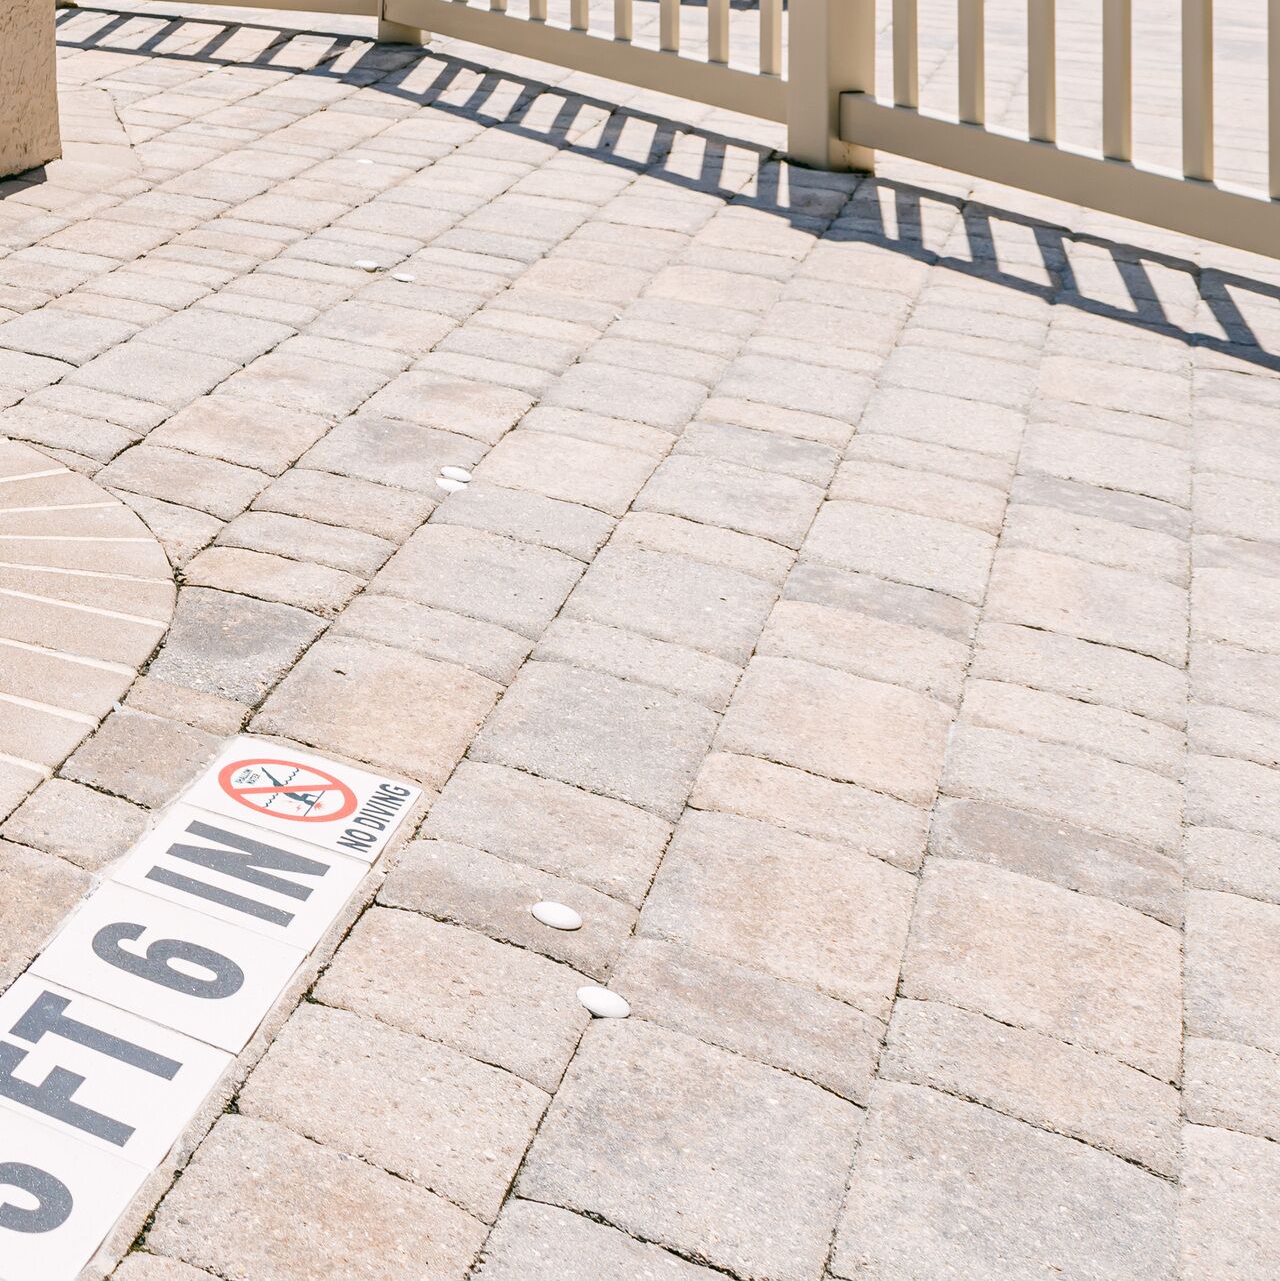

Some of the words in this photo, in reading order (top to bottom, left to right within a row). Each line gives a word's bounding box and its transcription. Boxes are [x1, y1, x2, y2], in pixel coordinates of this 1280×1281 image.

[353, 783, 411, 831] DIVING
[336, 828, 378, 853] NO
[144, 819, 331, 928] IN
[90, 921, 245, 1000] 6
